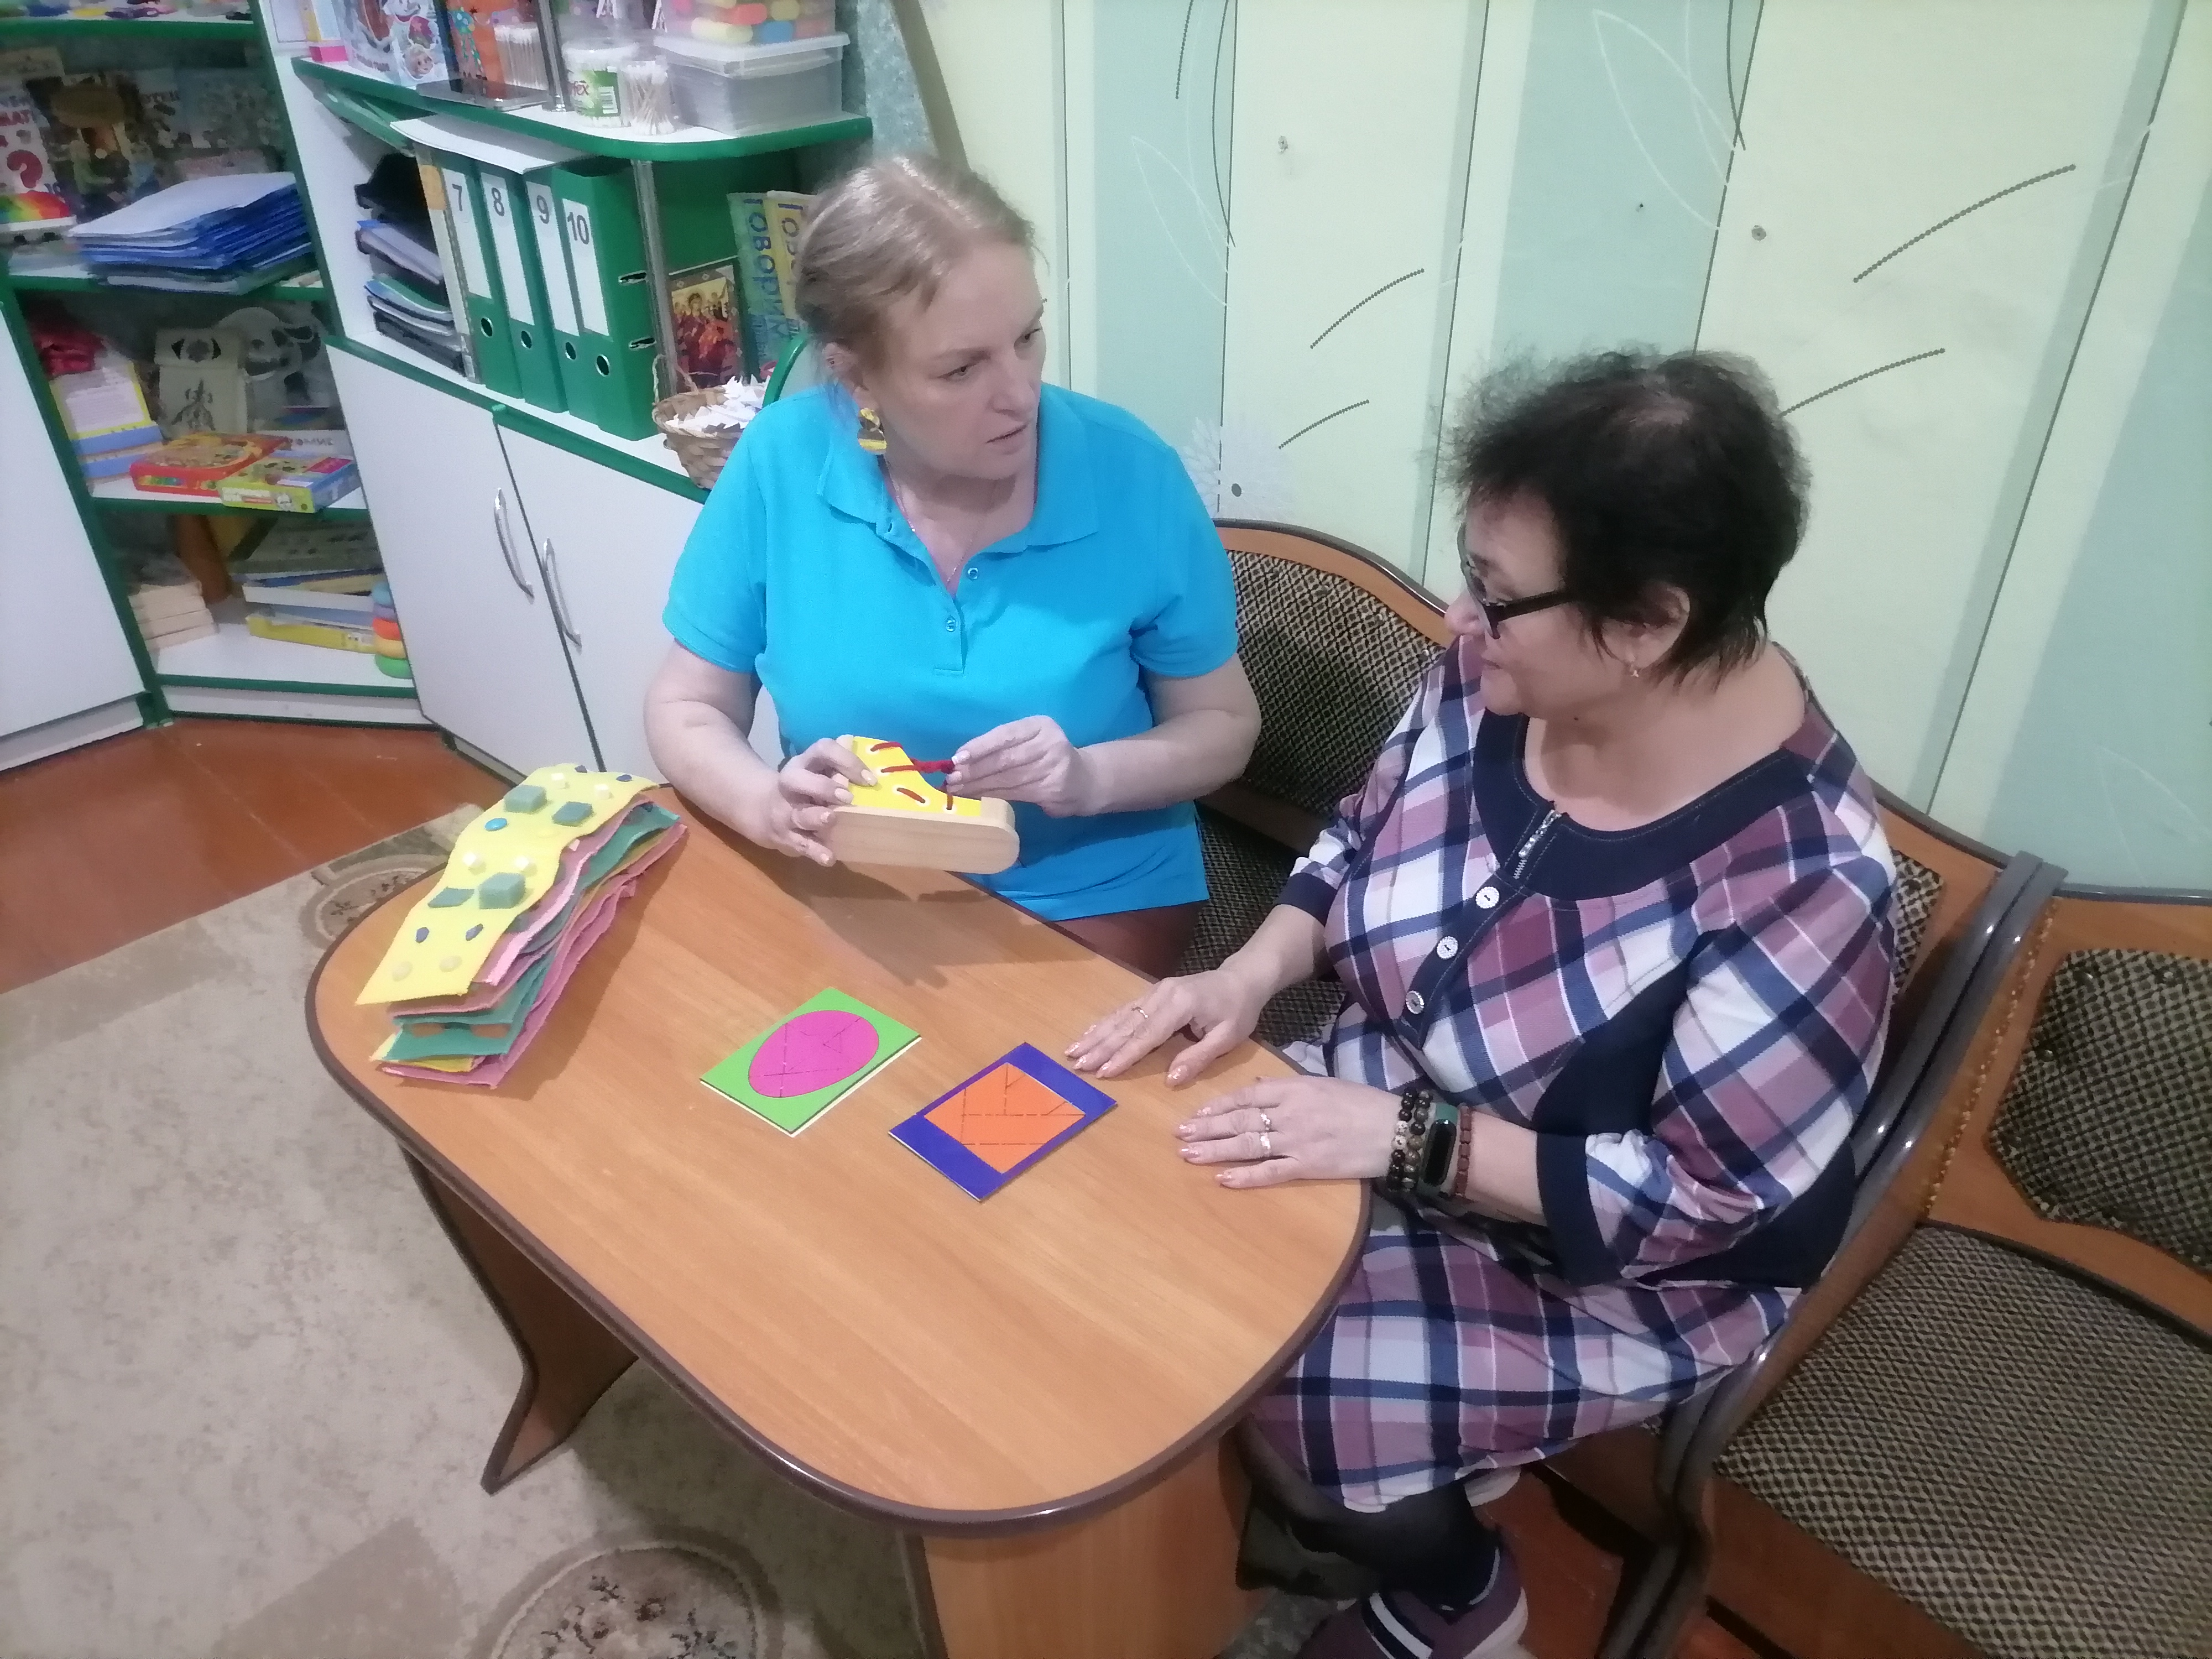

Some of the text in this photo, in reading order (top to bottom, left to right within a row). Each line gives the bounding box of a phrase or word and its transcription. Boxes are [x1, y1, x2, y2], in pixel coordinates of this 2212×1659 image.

[452, 184, 463, 212] 7
[491, 187, 505, 217] 8
[536, 195, 550, 225] 9
[567, 212, 590, 245] 10
